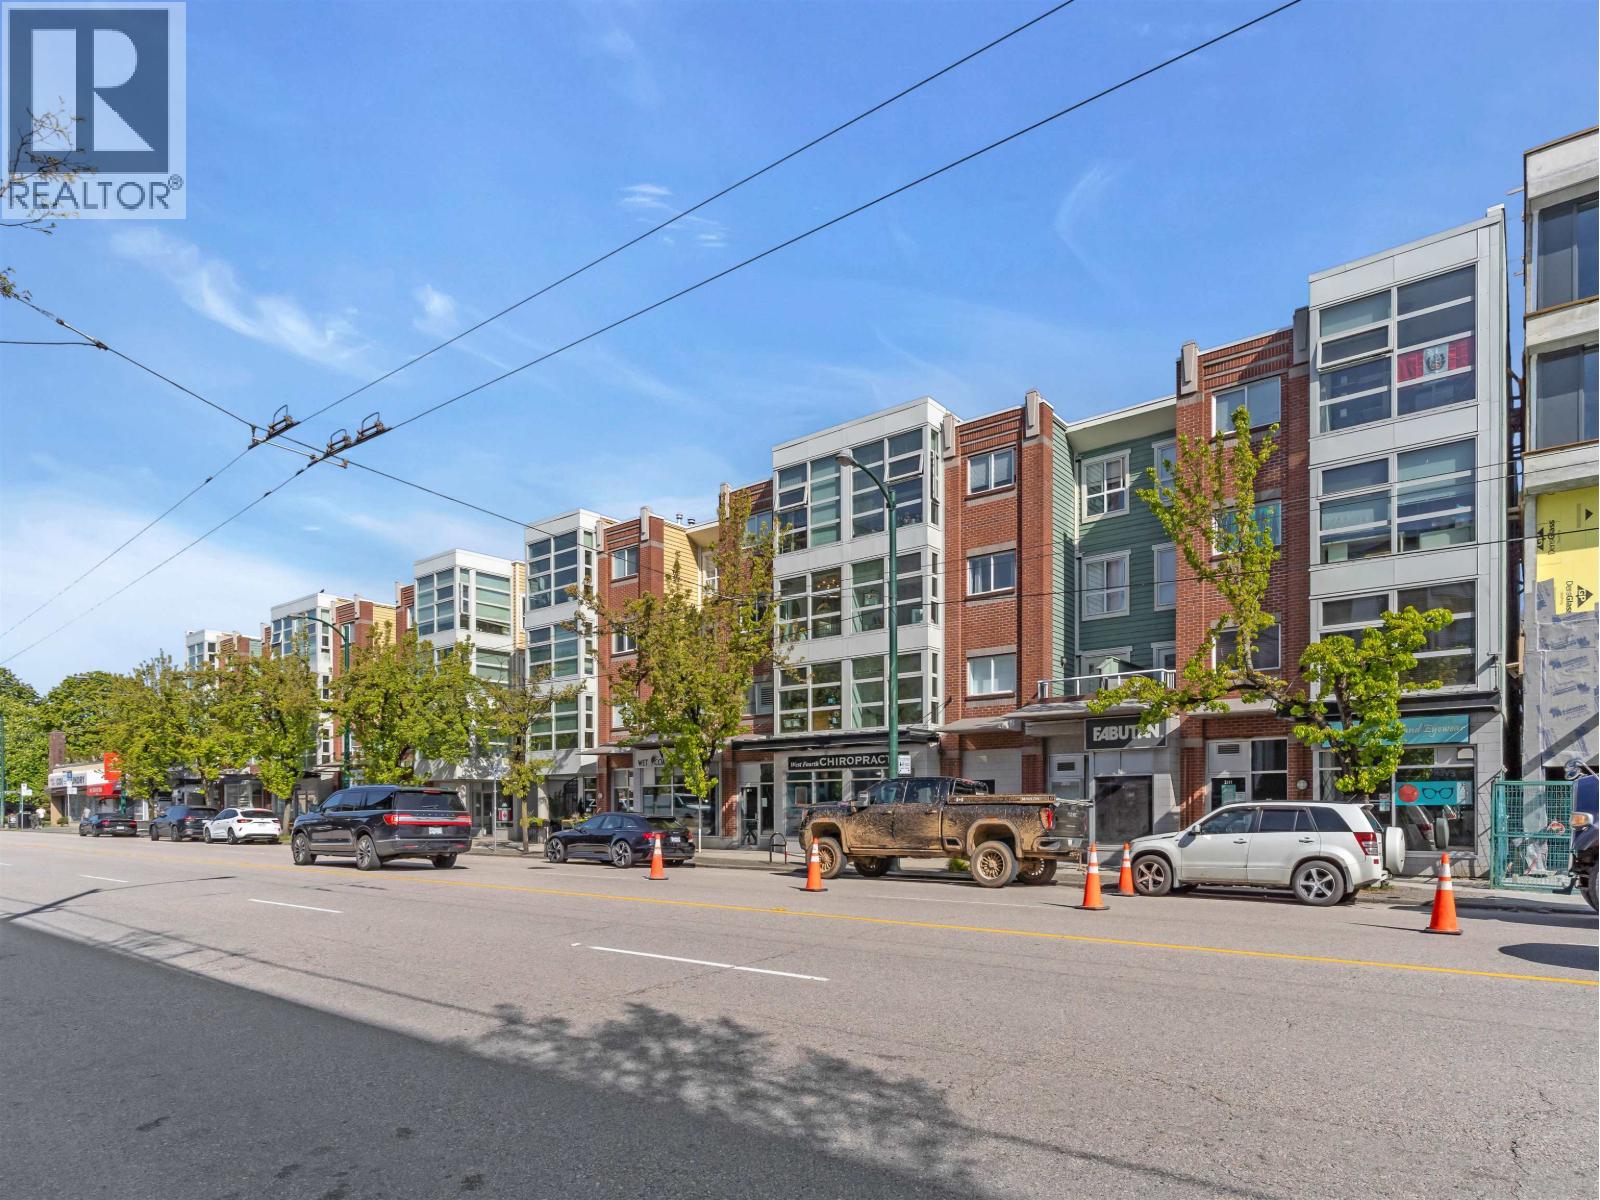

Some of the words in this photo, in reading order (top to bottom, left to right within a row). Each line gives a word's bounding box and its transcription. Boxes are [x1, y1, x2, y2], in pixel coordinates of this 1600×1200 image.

[1578, 589, 1586, 602] GP
[638, 759, 648, 767] WET
[802, 760, 819, 768] Fourth
[819, 755, 890, 766] CHIROPRACT
